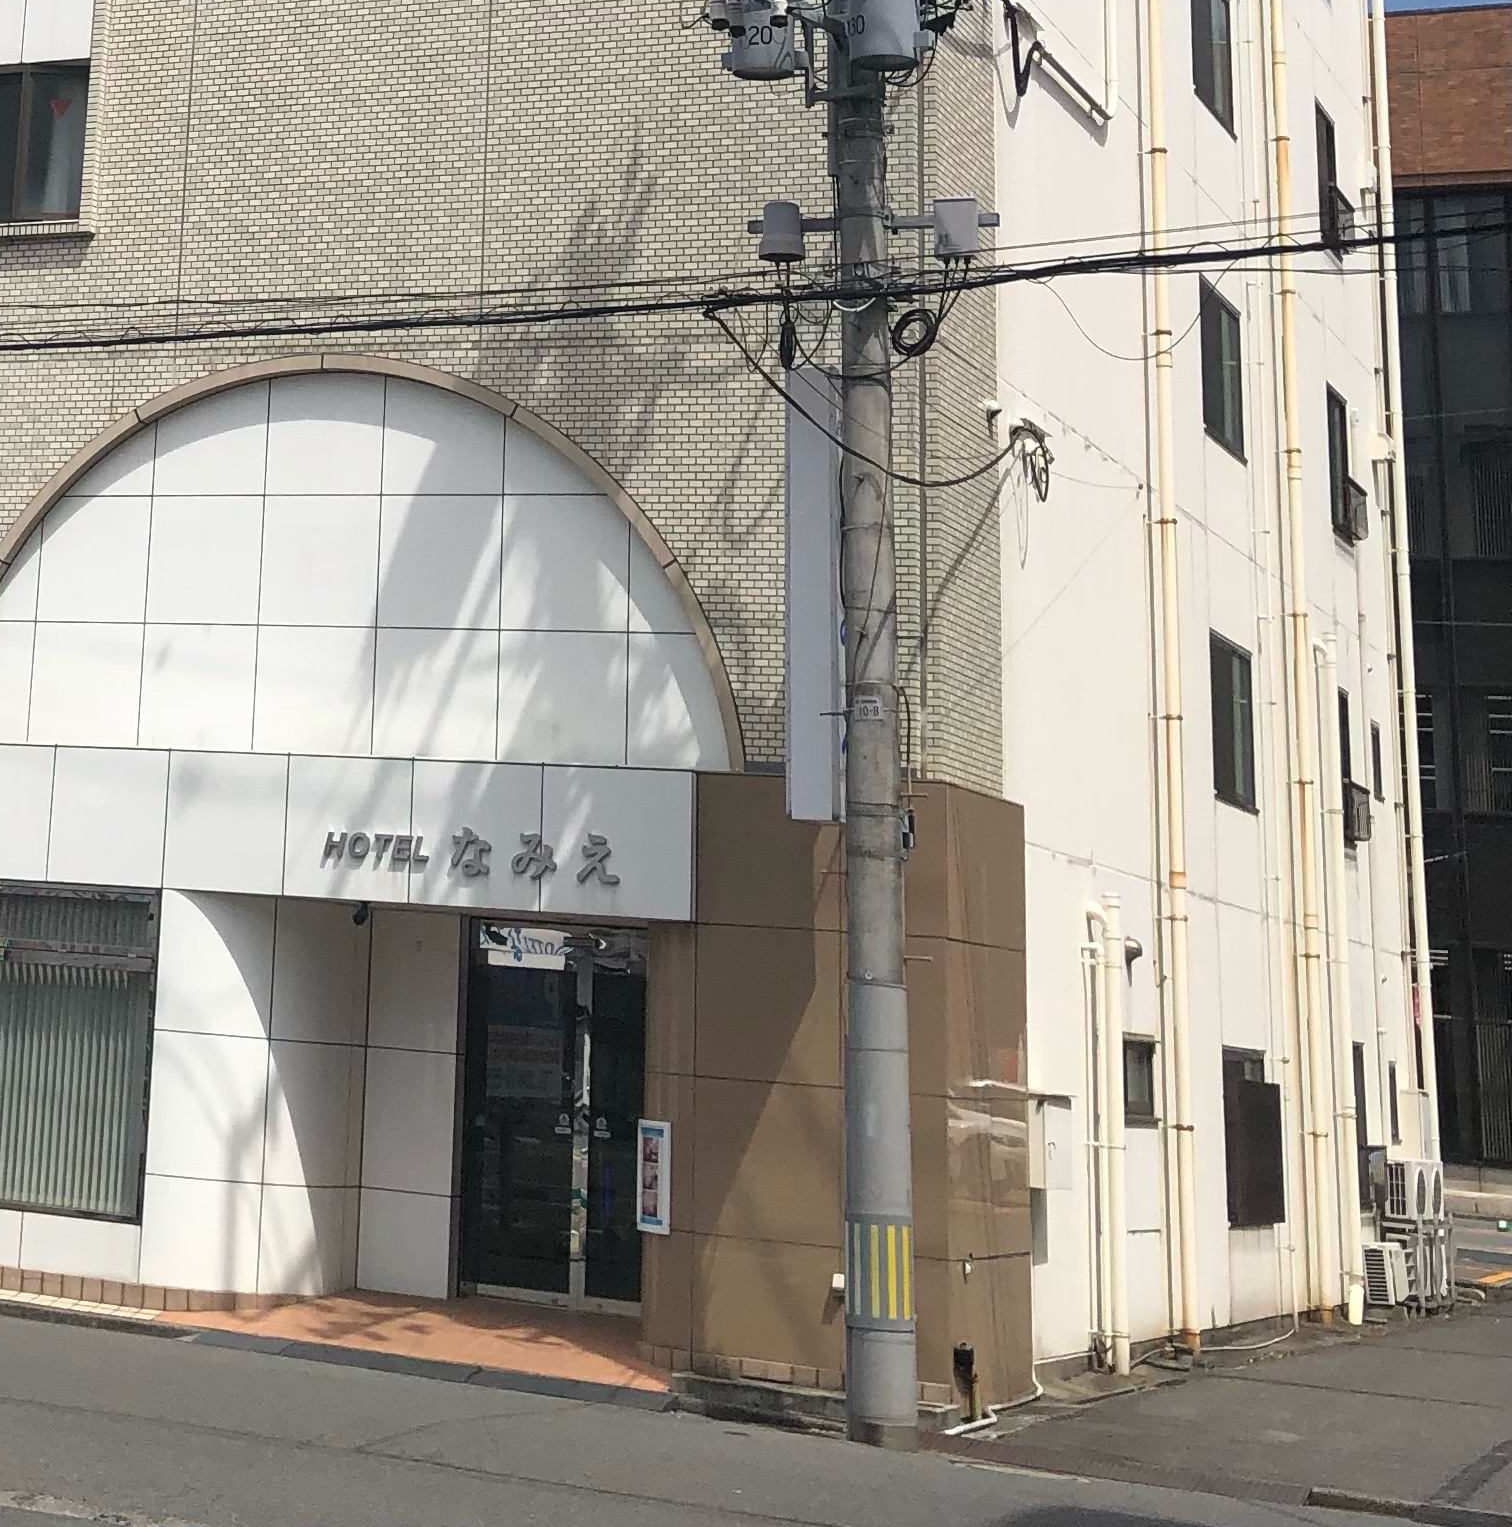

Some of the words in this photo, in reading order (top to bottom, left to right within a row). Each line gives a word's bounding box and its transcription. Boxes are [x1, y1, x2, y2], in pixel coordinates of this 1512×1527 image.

[748, 25, 773, 45] 20
[322, 831, 429, 865] HOTEL
[450, 827, 621, 885] なみえ
